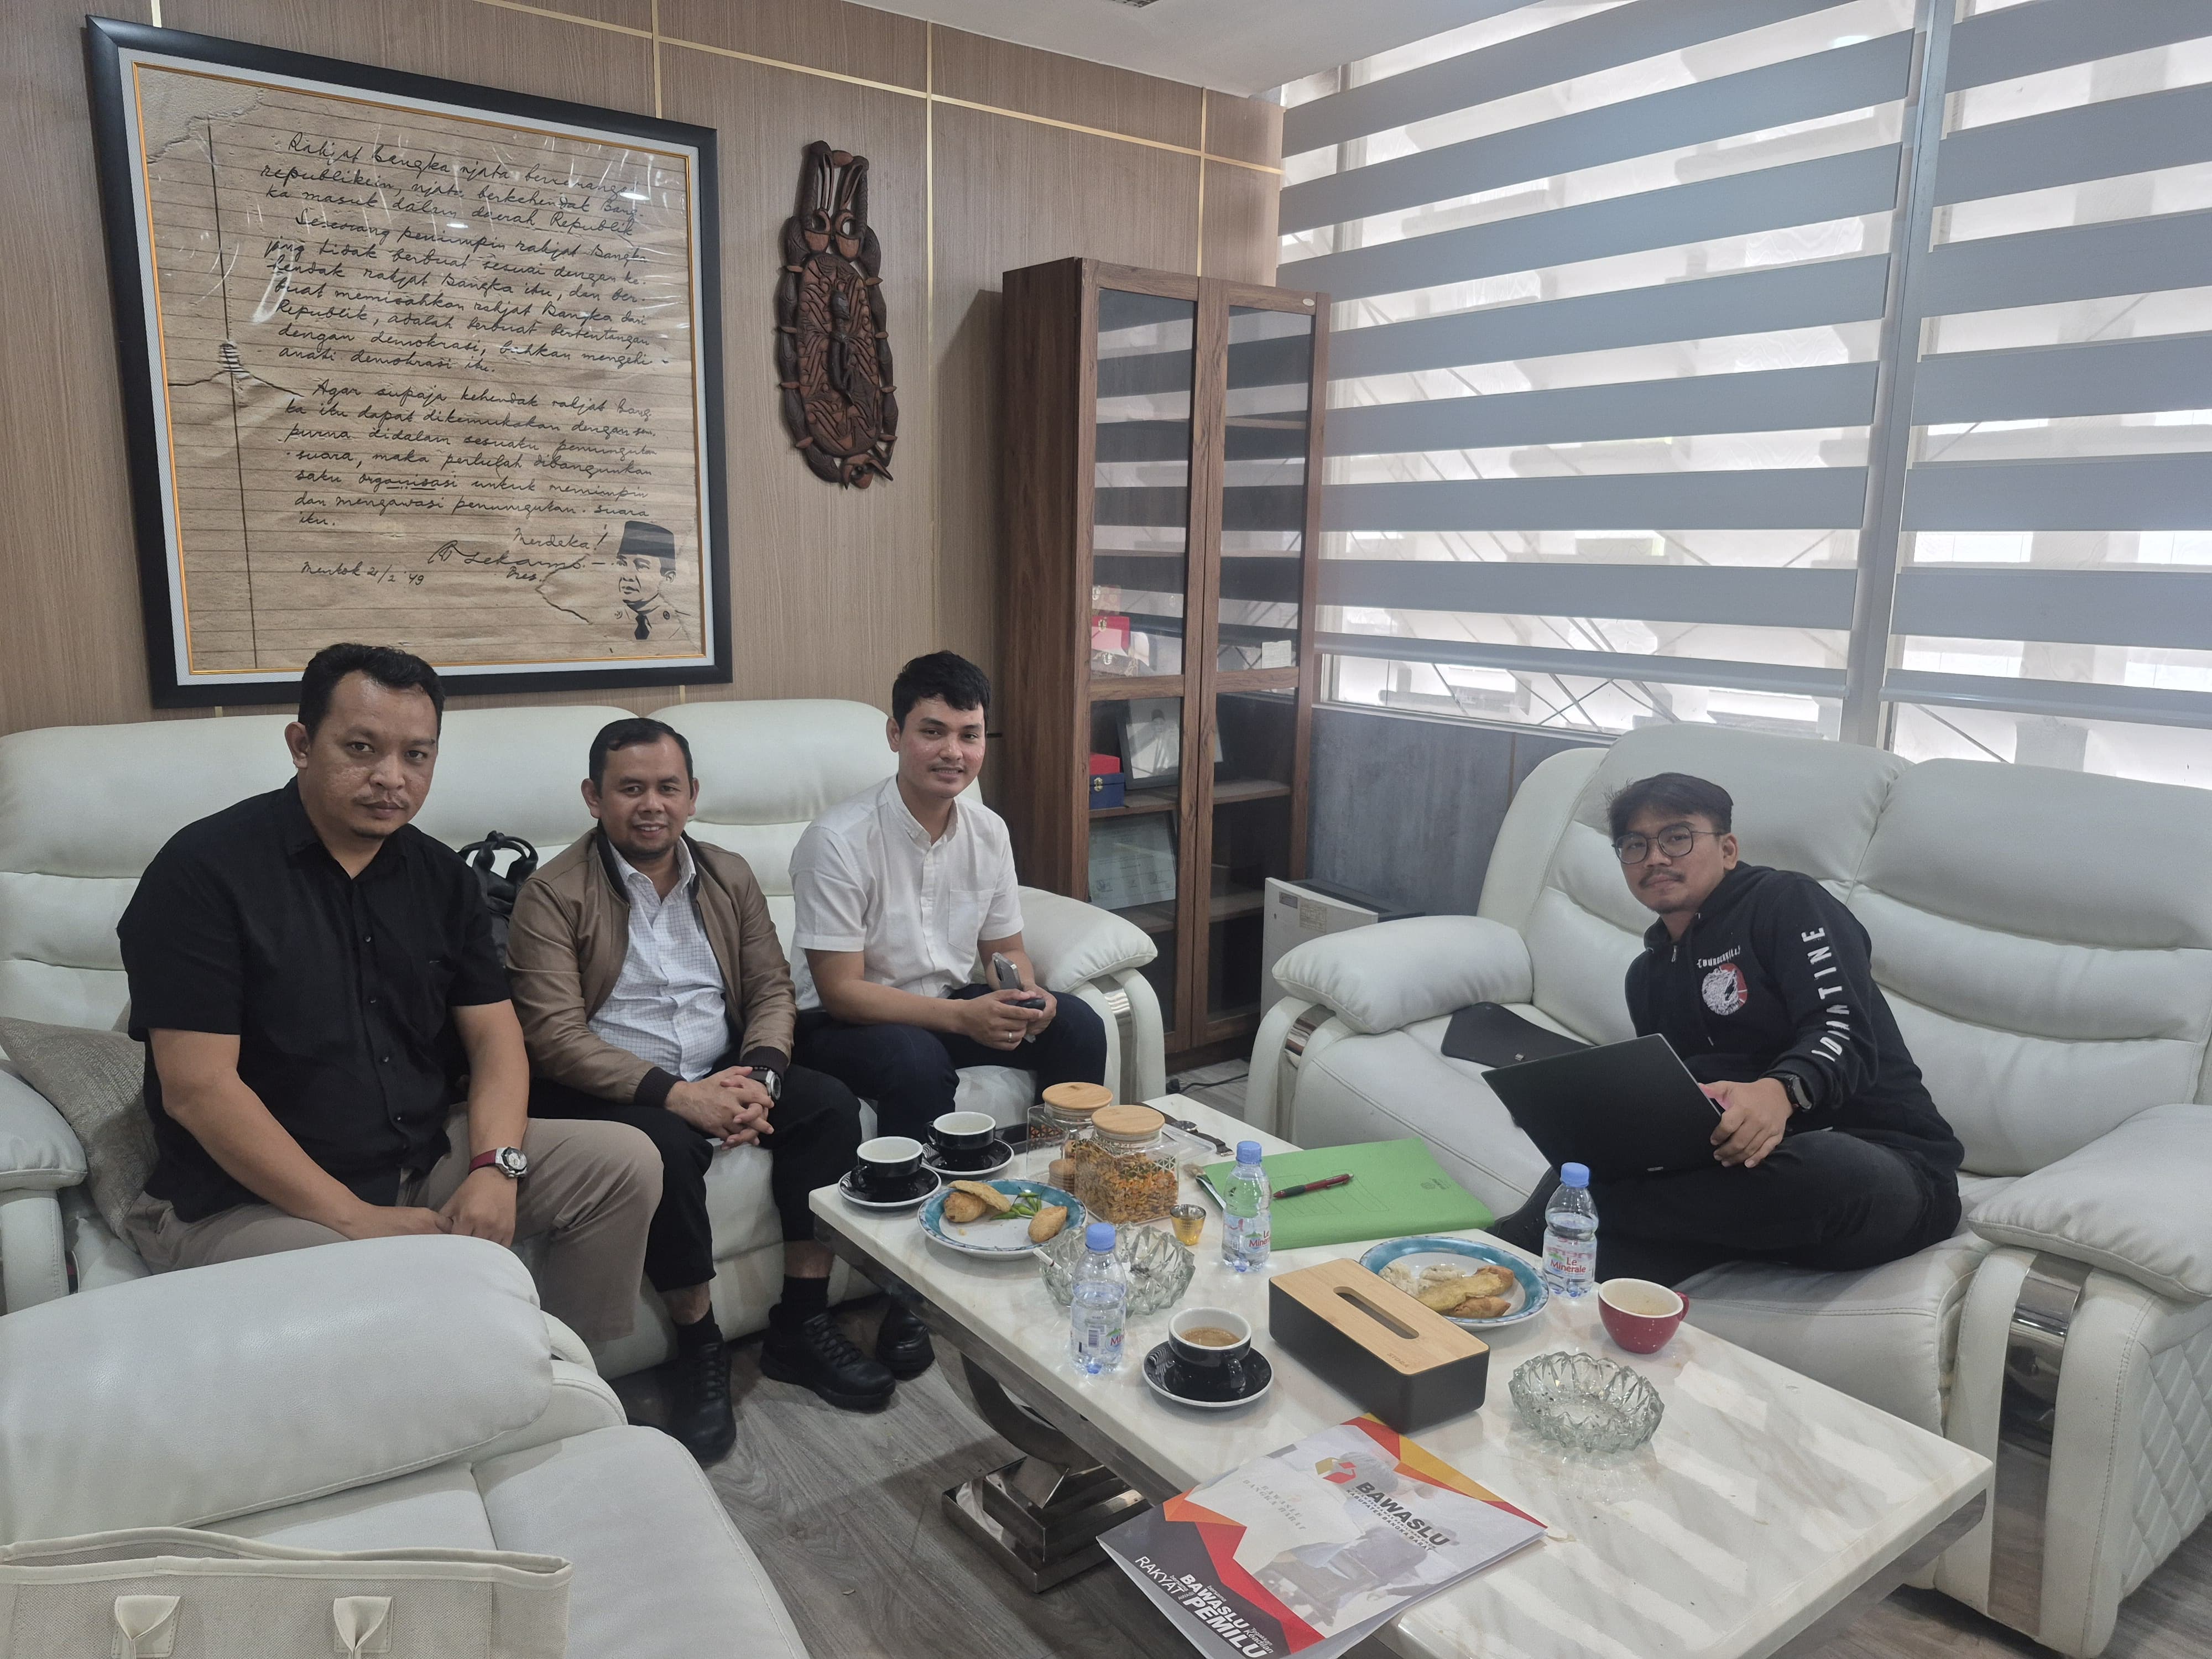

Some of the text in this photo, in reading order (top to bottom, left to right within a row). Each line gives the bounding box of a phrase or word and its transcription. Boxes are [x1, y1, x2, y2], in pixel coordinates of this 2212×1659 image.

[304, 192, 378, 208] masuk
[319, 238, 378, 259] tidak
[1550, 1259, 1586, 1273] Minerale
[1566, 1257, 1577, 1265] Le
[1355, 1482, 1450, 1546] BAWASLU
[1135, 1556, 1185, 1595] RAKYAT
[1180, 1574, 1250, 1629] BAWASLU
[1182, 1597, 1268, 1658] PEMILU
[1243, 1628, 1274, 1654] Keadilan
